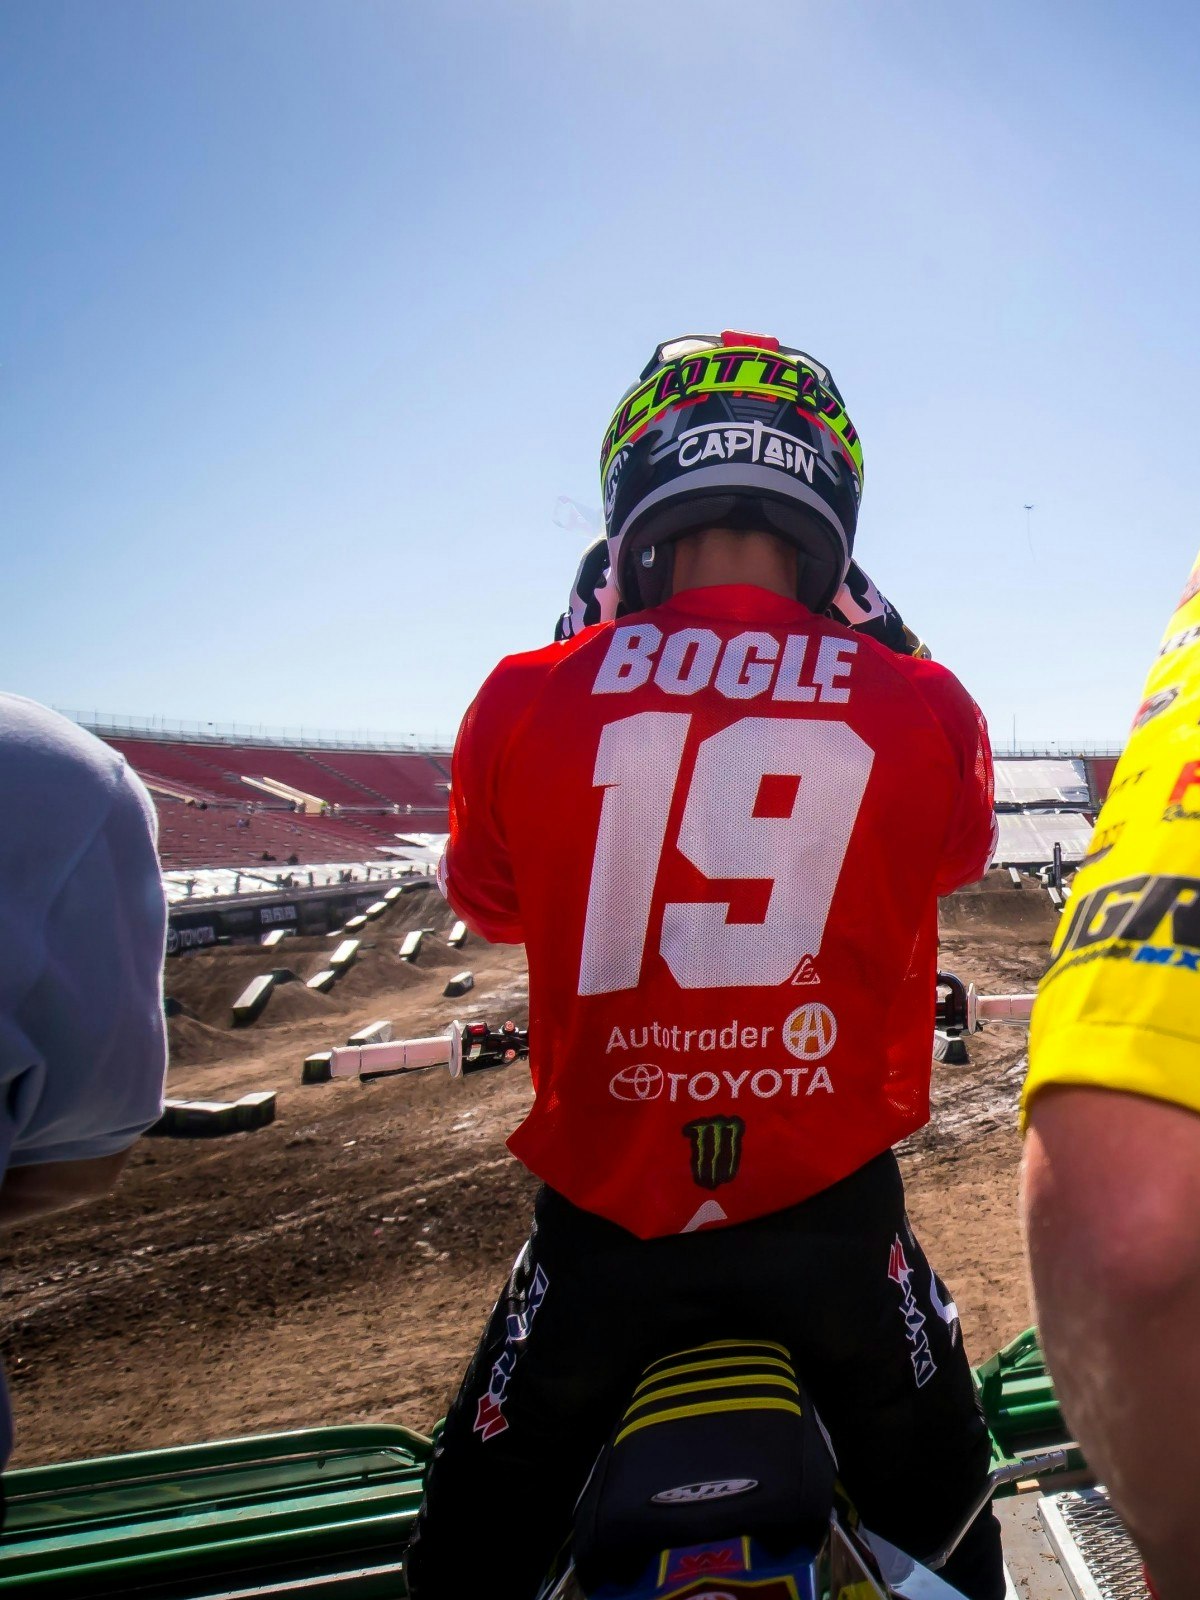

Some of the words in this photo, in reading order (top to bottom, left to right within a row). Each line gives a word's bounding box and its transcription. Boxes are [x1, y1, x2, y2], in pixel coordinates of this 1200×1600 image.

[591, 623, 858, 703] BOGLE
[577, 711, 875, 996] 19
[605, 1020, 774, 1055] Autotrader
[668, 1065, 835, 1102] TOYOTA
